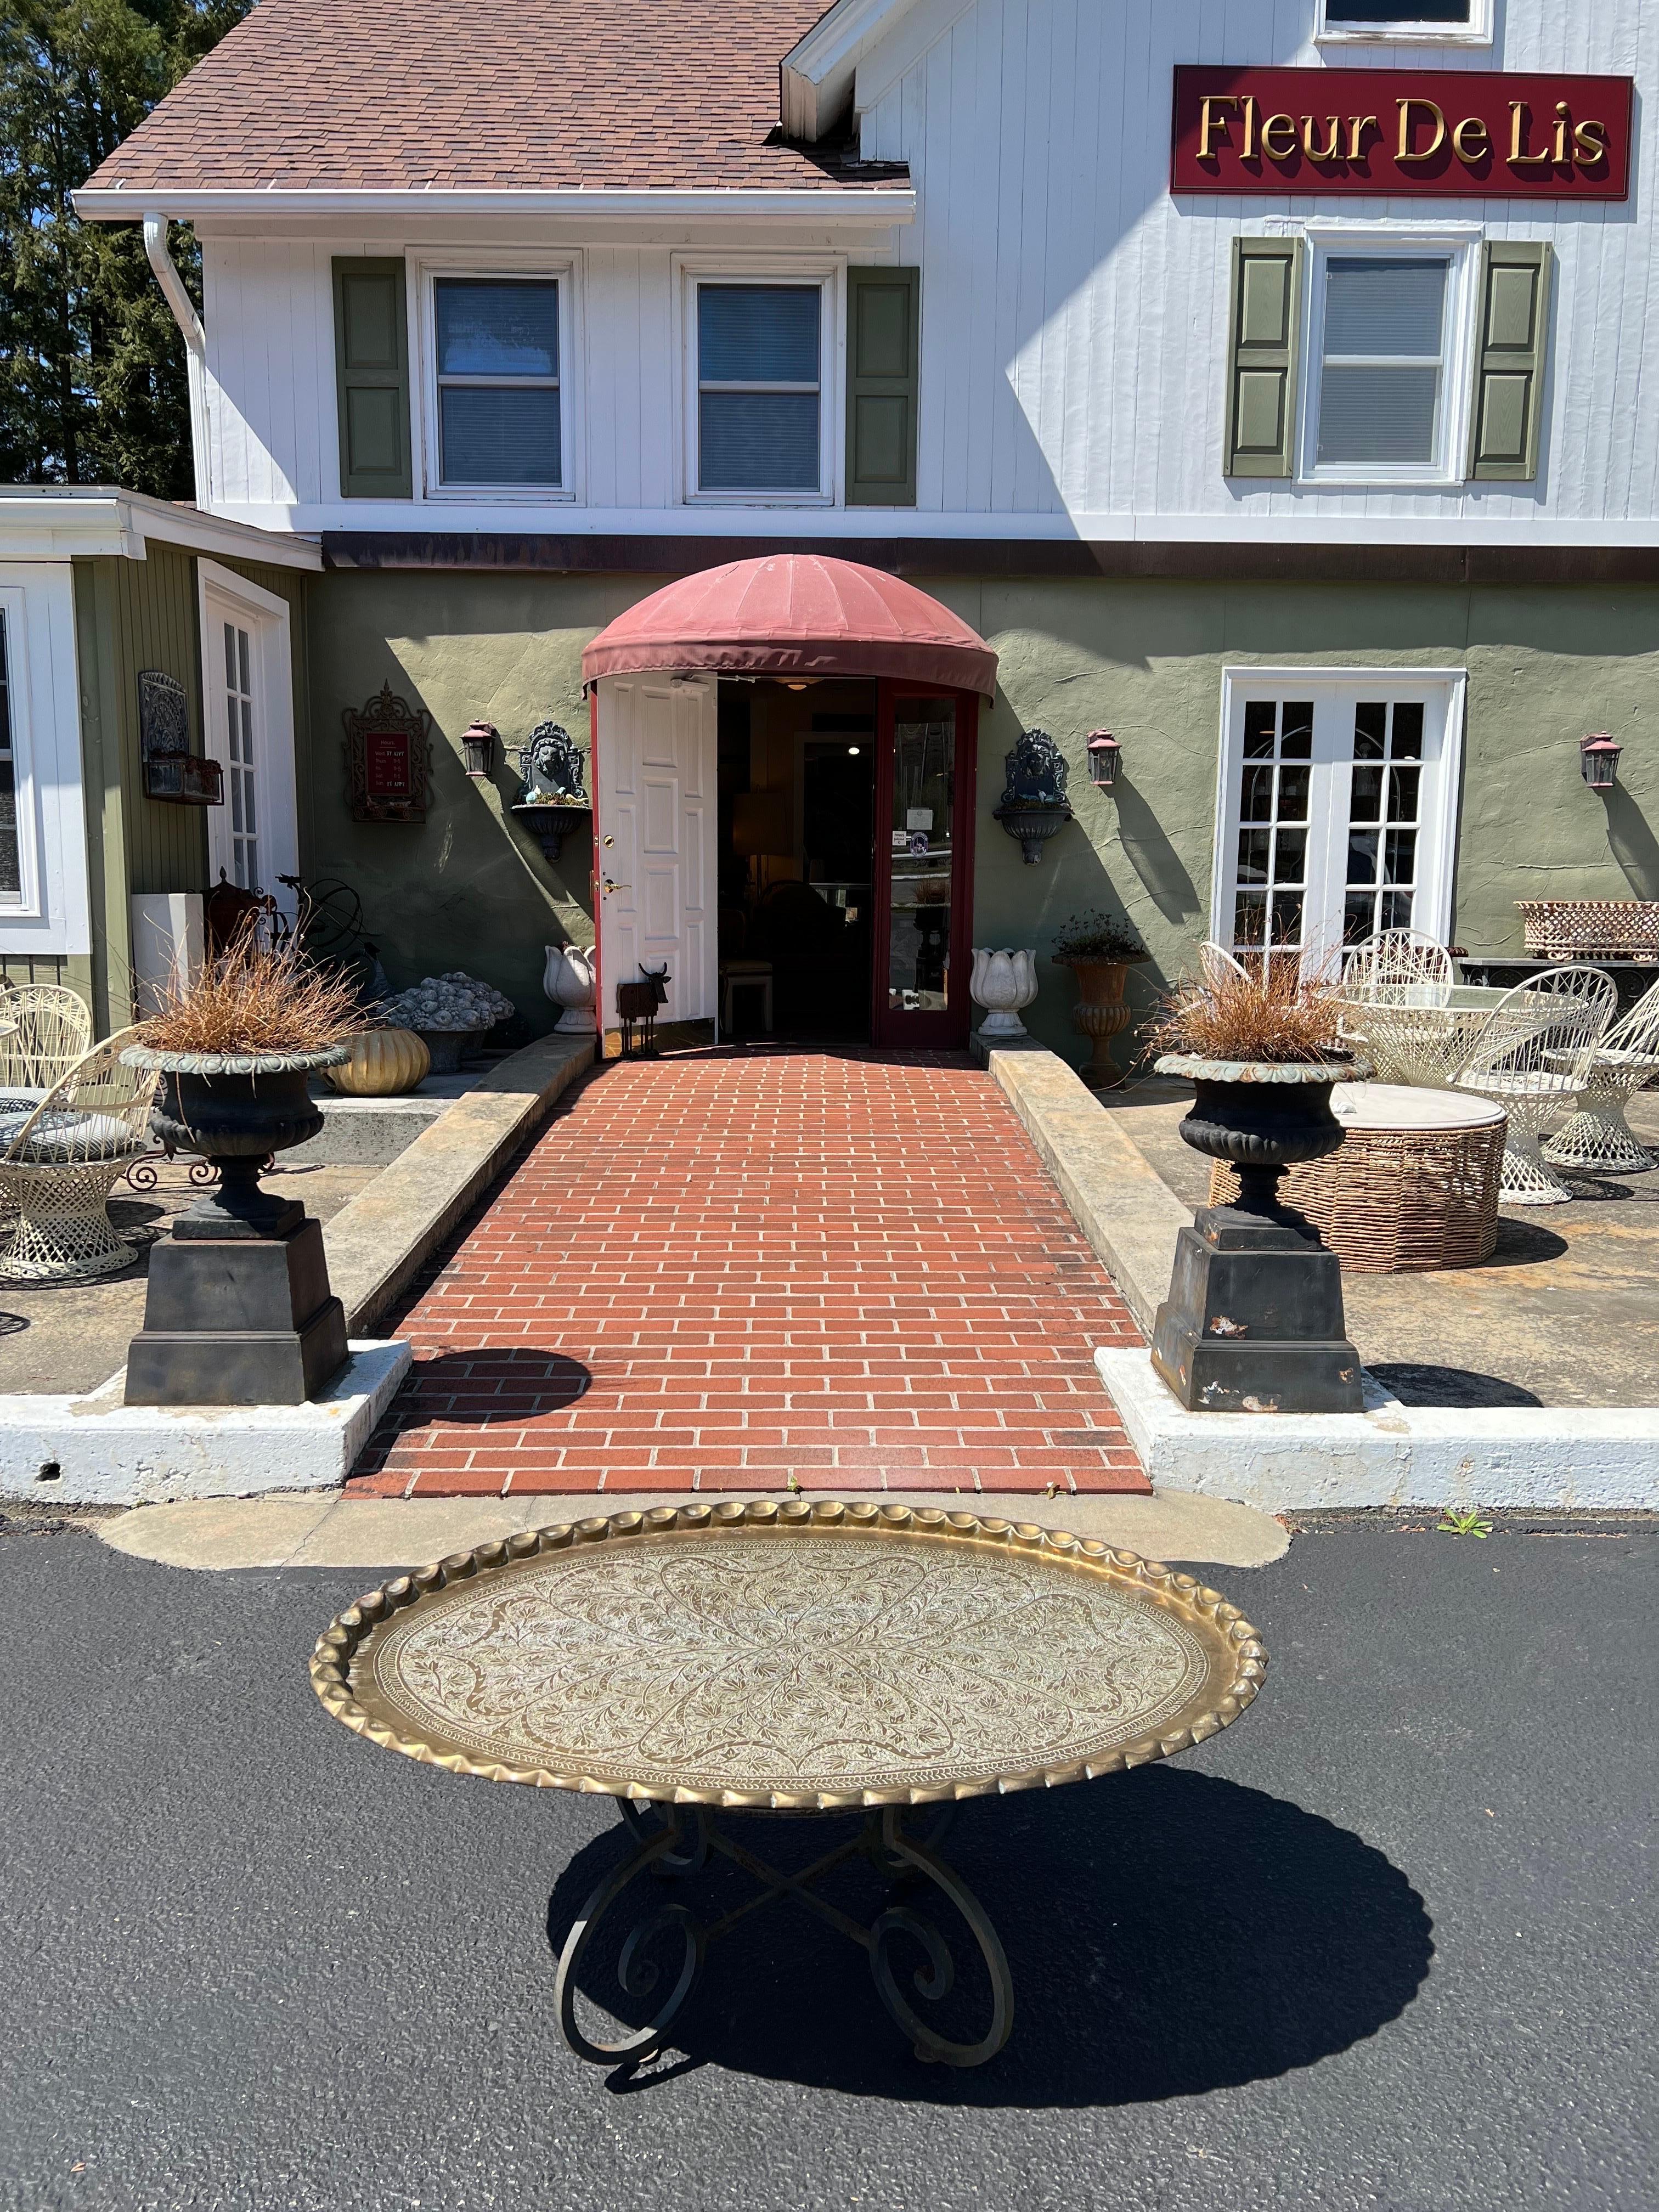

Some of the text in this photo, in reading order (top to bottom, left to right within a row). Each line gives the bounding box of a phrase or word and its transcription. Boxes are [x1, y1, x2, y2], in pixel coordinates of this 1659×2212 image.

[1195, 95, 1605, 166] Fleur De Lis
